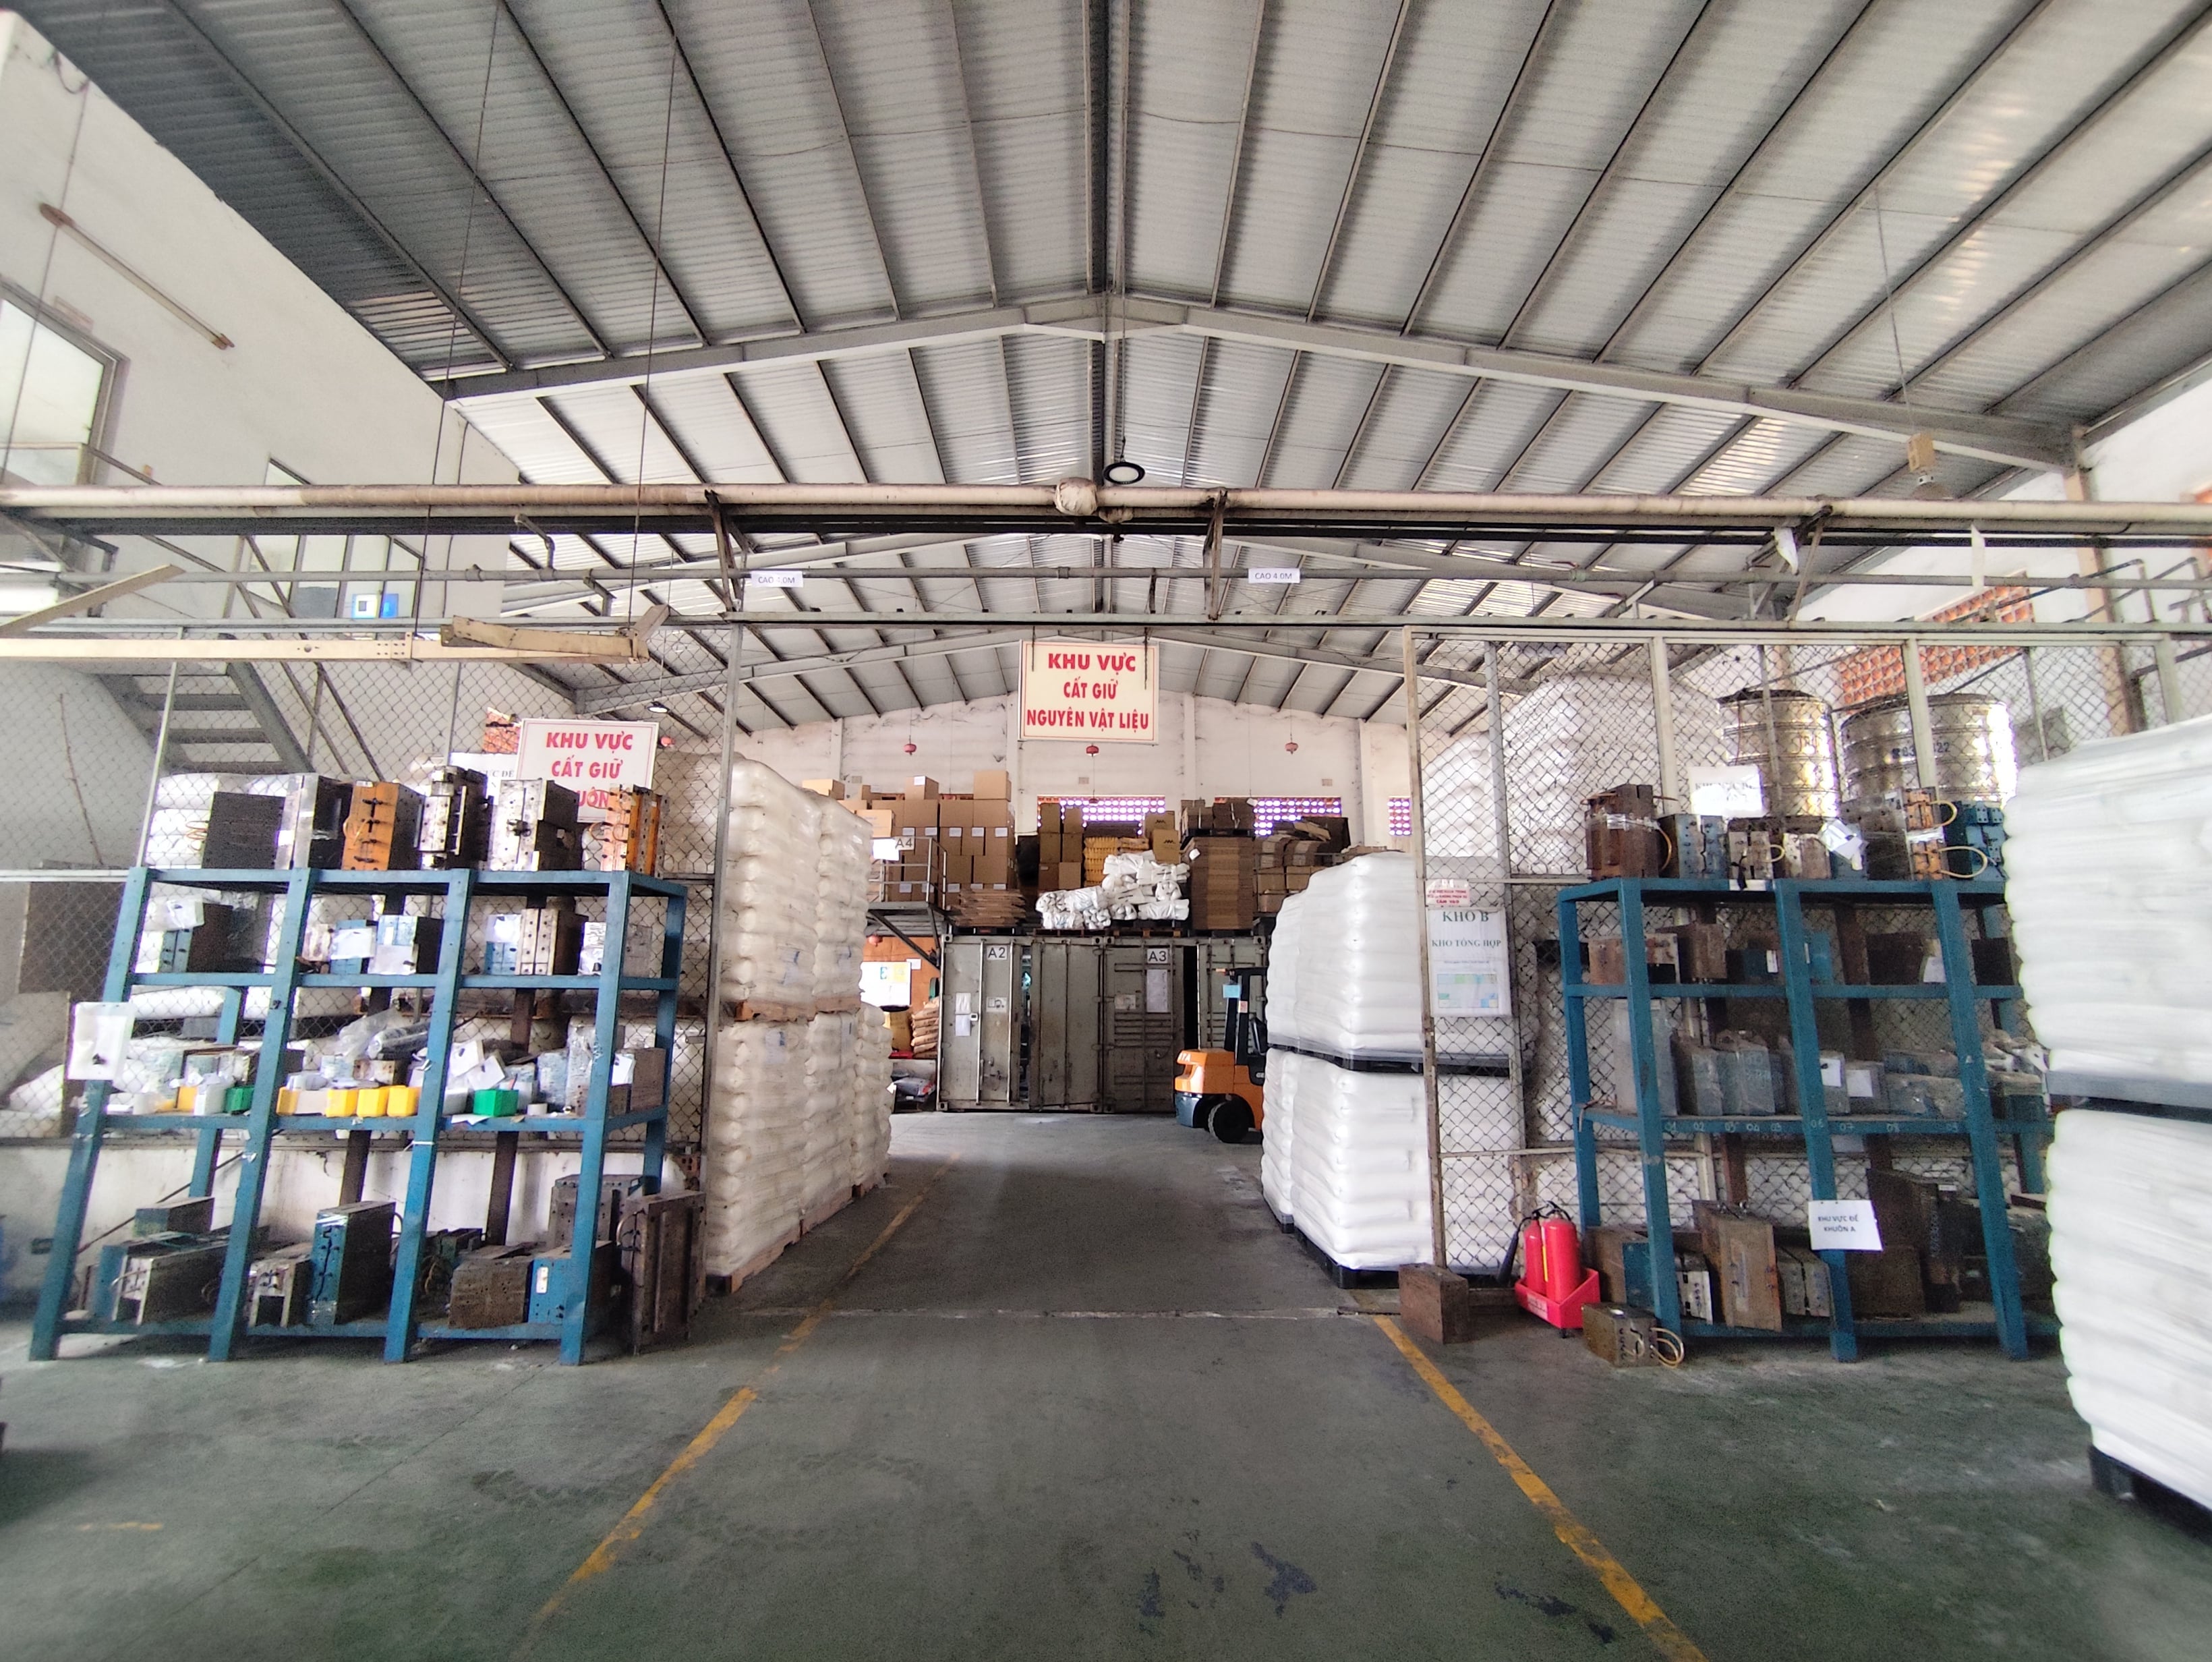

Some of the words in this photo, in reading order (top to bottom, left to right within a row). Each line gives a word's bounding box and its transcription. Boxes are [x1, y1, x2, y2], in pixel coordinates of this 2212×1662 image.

[1048, 653, 1090, 670] KHU
[1097, 652, 1136, 675] VỰC
[1064, 676, 1087, 698] CẤT
[1093, 679, 1118, 699] GIỮ
[1026, 706, 1084, 727] NGUYÊN
[1089, 708, 1115, 732] VẬT
[1119, 709, 1148, 733] LIỆU
[546, 732, 588, 748] KHU
[595, 730, 633, 753] VỰC
[552, 755, 583, 777] CẤT
[589, 758, 623, 778] GIỮ
[895, 838, 912, 849] A4
[1443, 911, 1476, 922] KHO
[1481, 911, 1489, 922] B
[988, 947, 1006, 958] A2
[1148, 950, 1167, 963] A3
